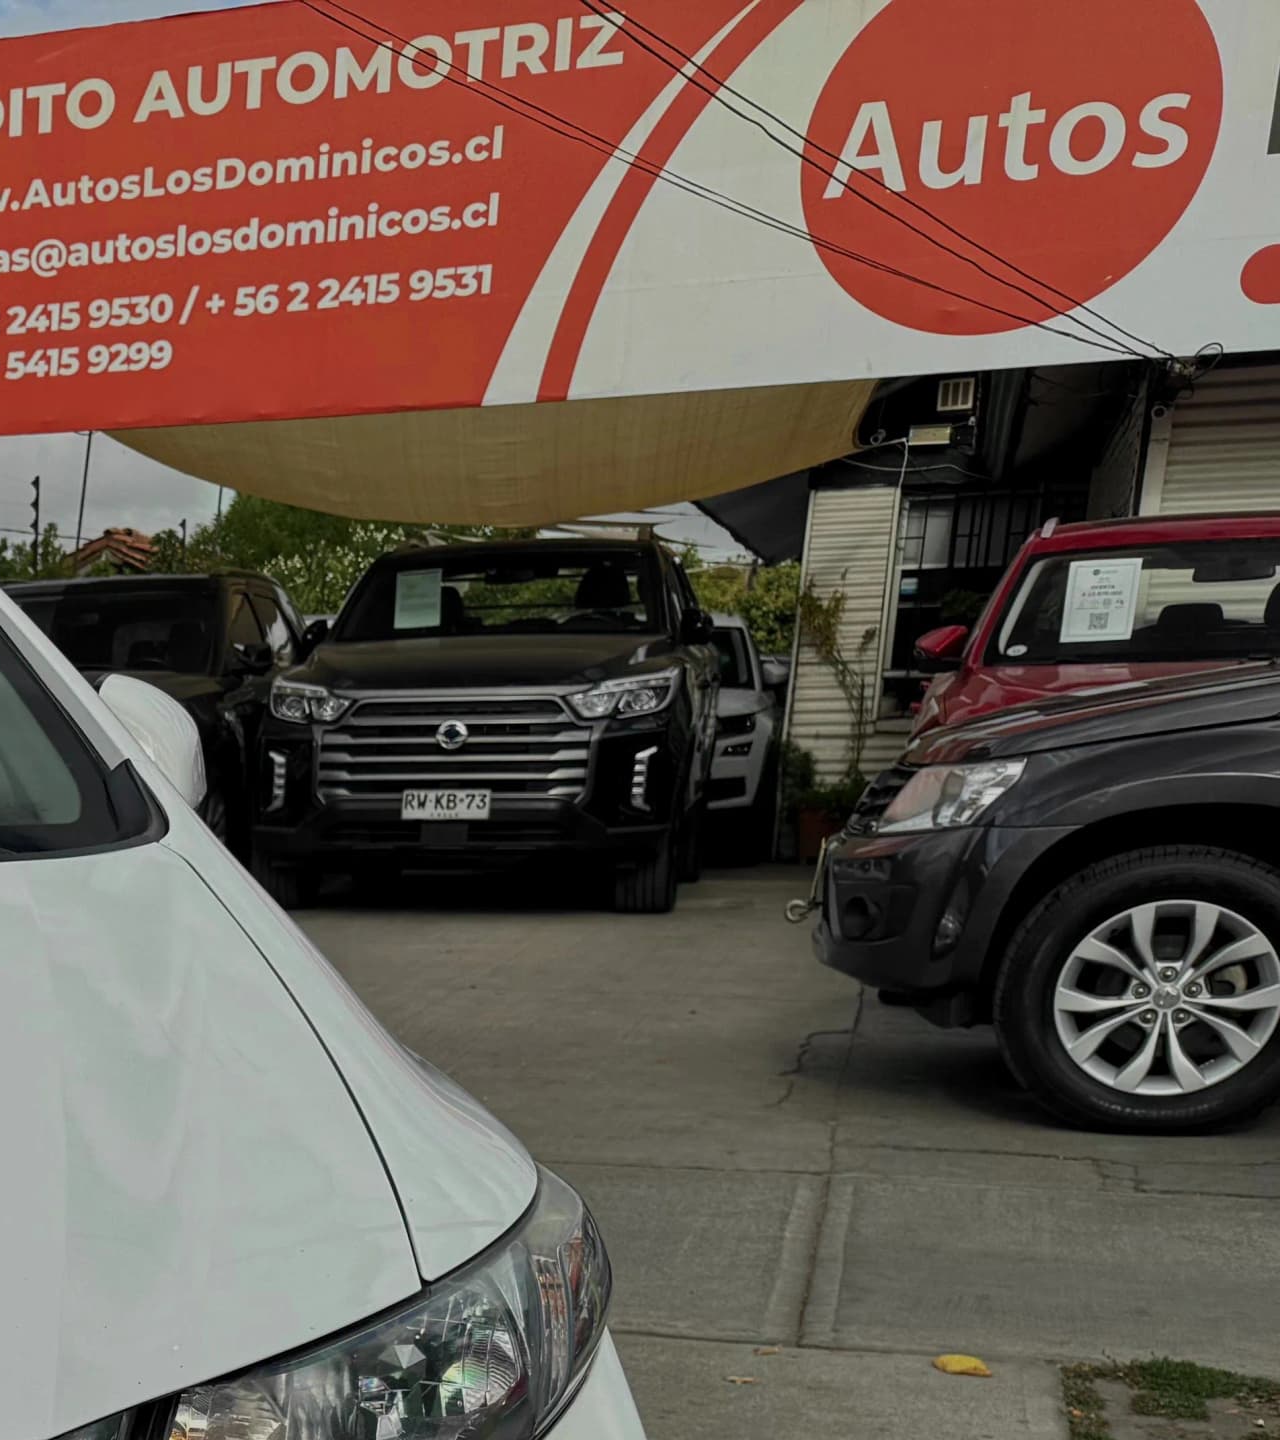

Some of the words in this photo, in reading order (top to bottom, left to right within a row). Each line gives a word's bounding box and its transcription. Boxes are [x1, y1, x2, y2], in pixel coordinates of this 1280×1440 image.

[132, 11, 627, 124] AUTOMOTRIZ
[822, 91, 1192, 201] Autos
[6, 301, 81, 335] 2415
[87, 293, 174, 329] 9530
[233, 283, 280, 317] 56
[286, 281, 310, 313] 2
[316, 269, 401, 310] 2415
[408, 263, 493, 301] 9531
[4, 346, 80, 380] 5415
[87, 339, 173, 374] 9299
